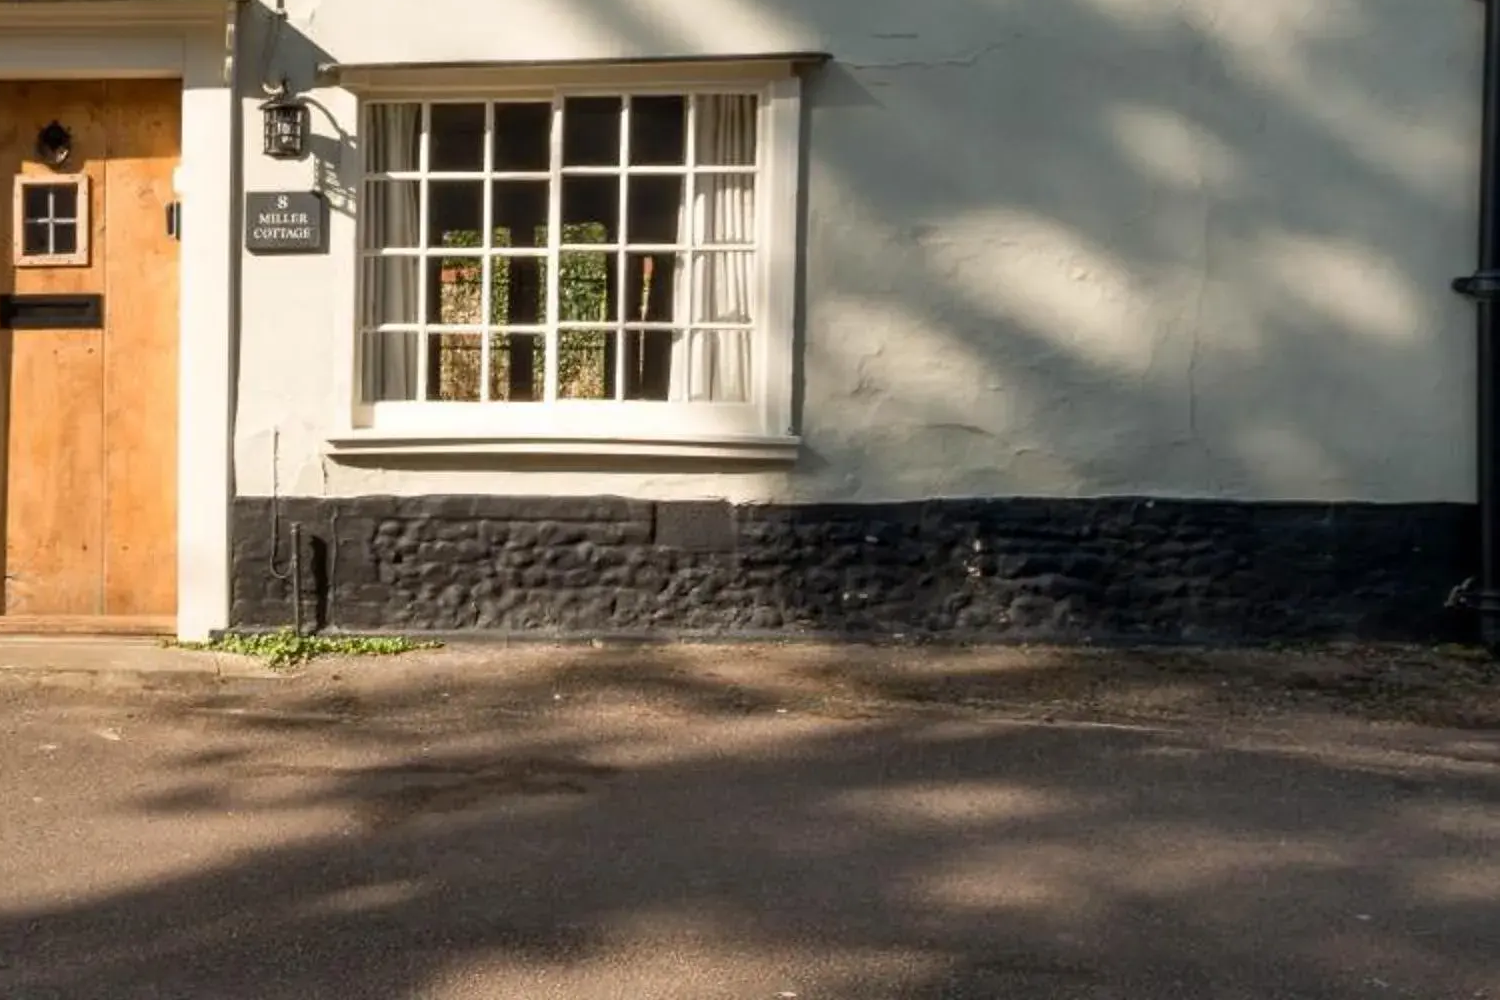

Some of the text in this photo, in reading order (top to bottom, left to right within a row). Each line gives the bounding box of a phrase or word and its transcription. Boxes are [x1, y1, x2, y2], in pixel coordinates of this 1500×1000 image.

[277, 195, 289, 209] 8
[259, 213, 308, 224] MILLER
[253, 227, 310, 239] COTTAGE
